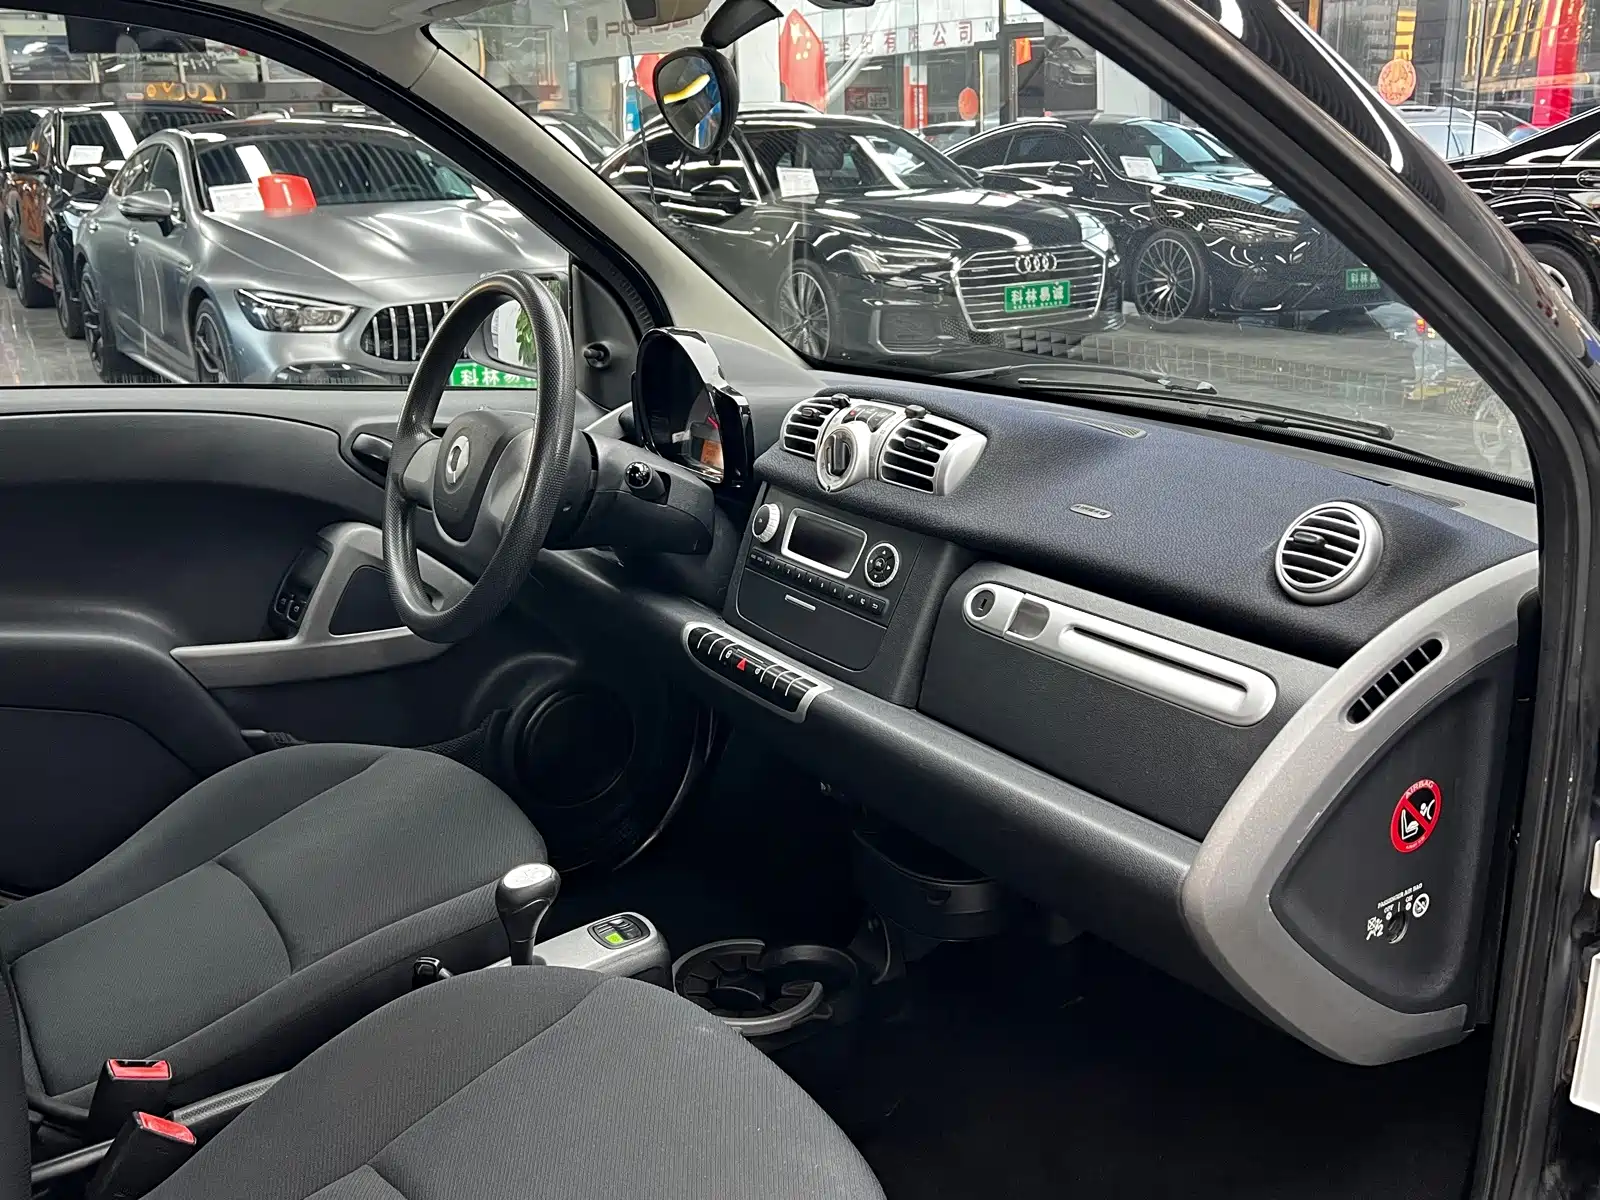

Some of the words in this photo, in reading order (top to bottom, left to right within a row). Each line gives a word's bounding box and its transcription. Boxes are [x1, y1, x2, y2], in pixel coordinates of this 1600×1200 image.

[1010, 284, 1064, 304] 科林易诚
[1405, 779, 1435, 800] AIRBAG
